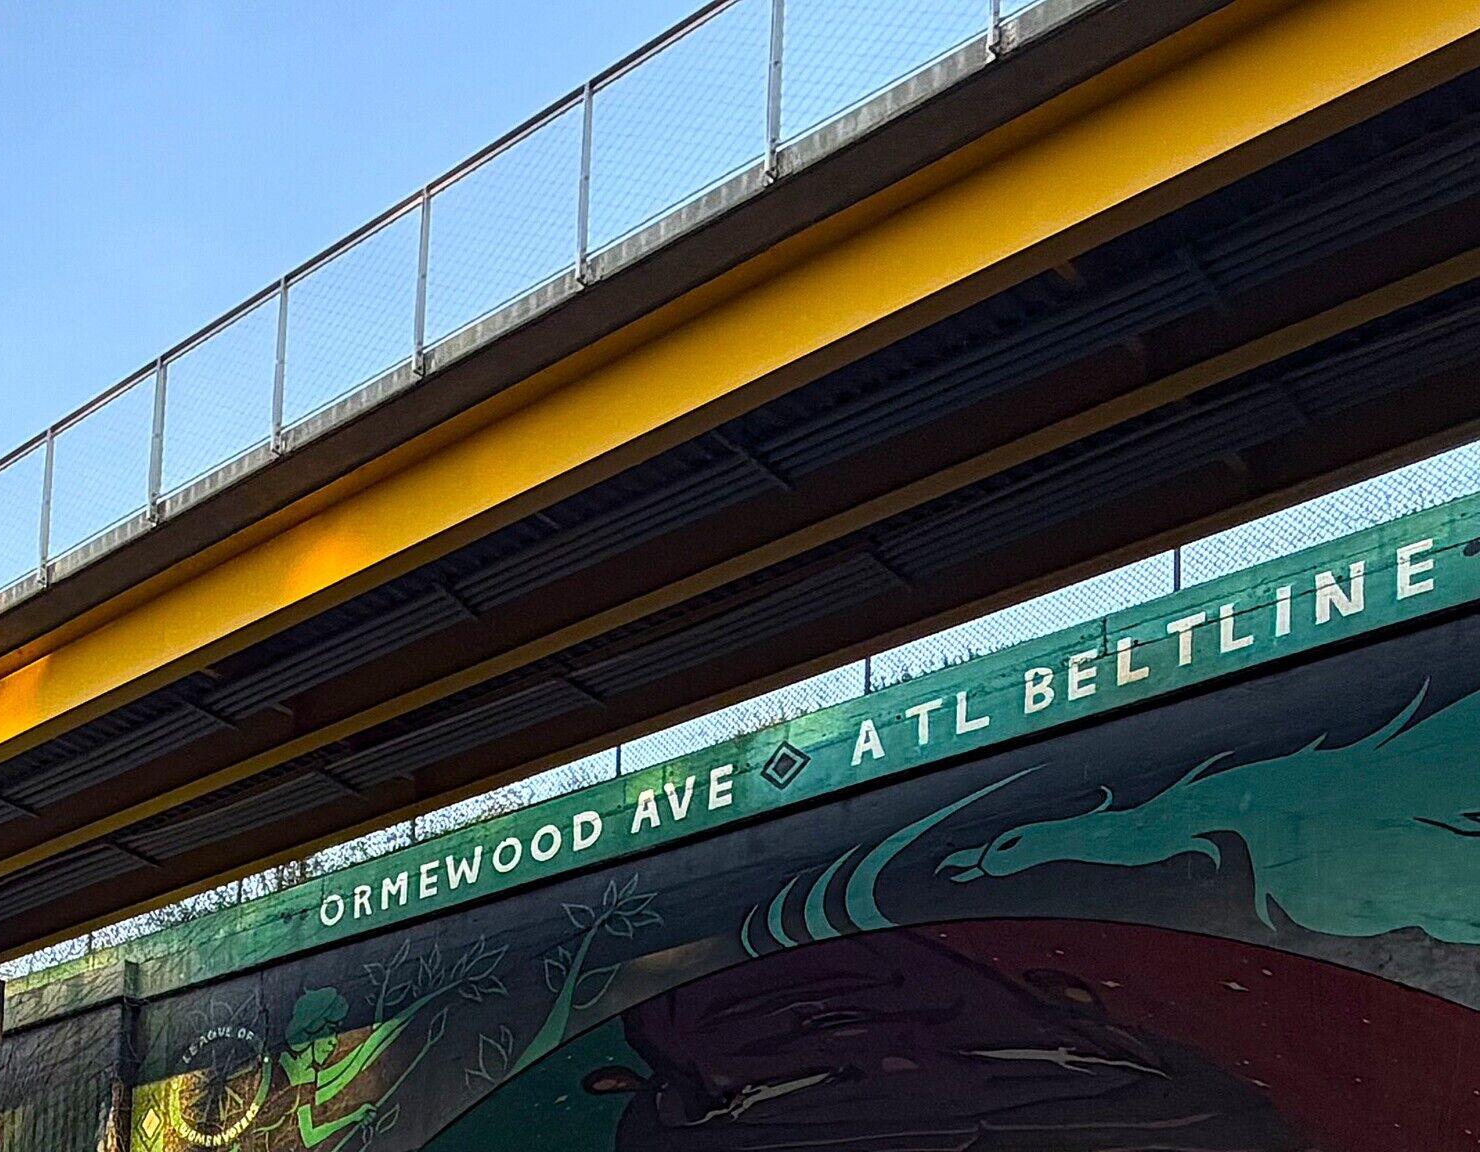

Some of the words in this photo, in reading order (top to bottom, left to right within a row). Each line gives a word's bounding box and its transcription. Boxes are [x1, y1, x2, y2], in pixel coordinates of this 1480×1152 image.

[320, 810, 603, 926] ORMEWOOD
[631, 764, 735, 834] AVE
[851, 692, 989, 766] ATL
[1023, 538, 1434, 714] BELTLINE
[237, 1027, 255, 1040] OF
